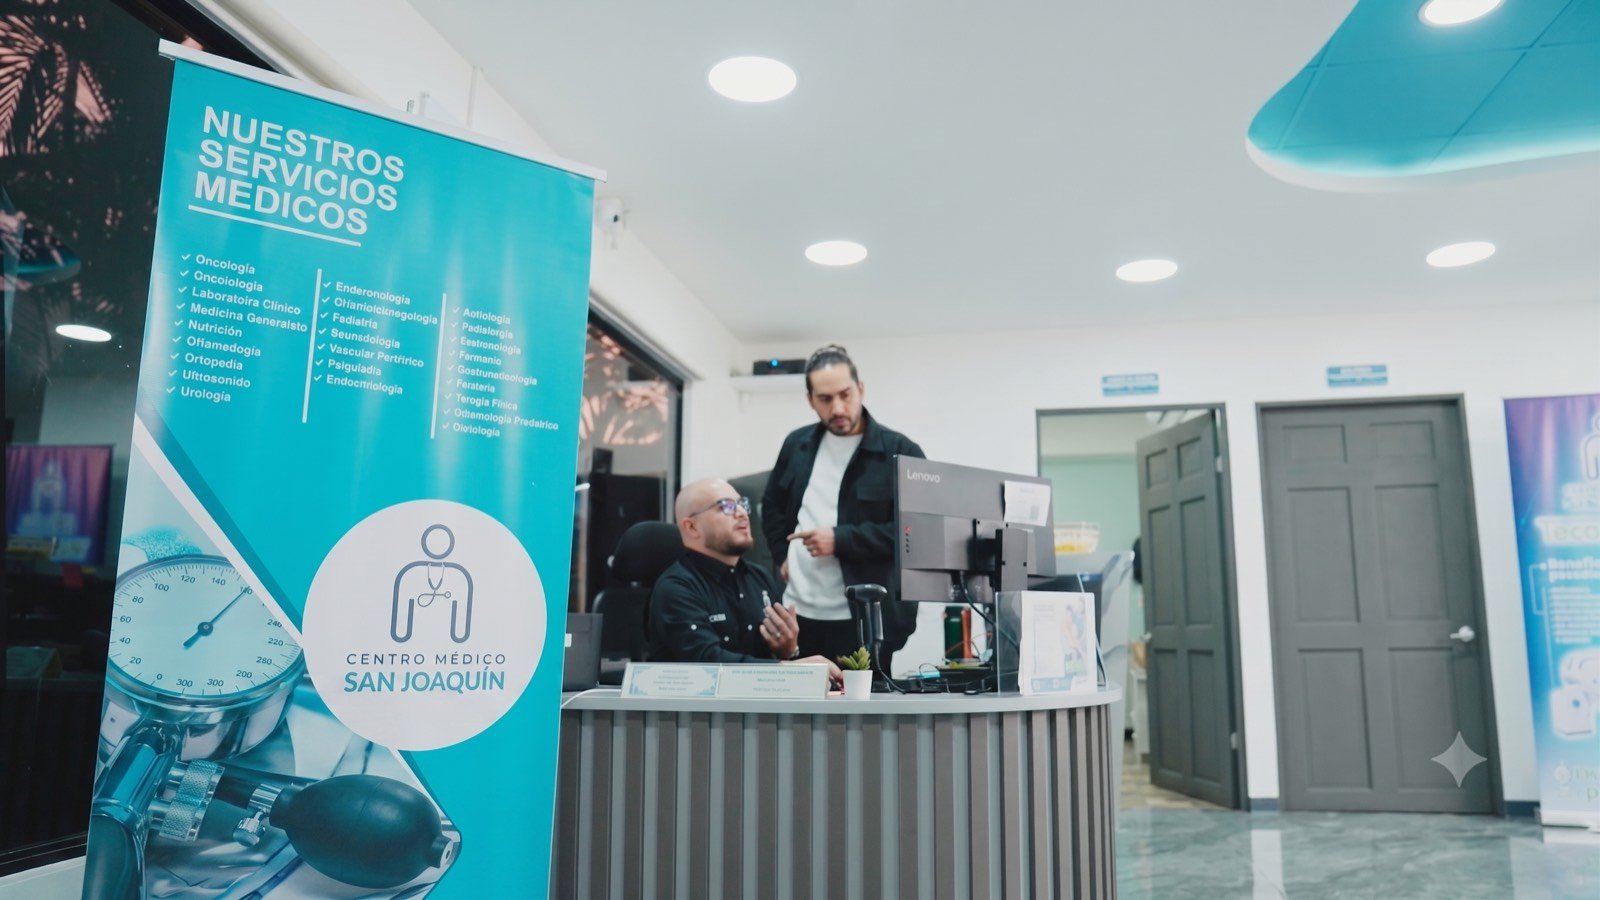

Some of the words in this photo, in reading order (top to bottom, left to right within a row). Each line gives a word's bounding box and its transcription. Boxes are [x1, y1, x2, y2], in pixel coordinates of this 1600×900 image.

[203, 105, 404, 182] NUESTROS
[199, 139, 398, 212] SERVICIOS
[195, 171, 368, 235] MEDICOS
[195, 254, 256, 275] Oncología
[190, 302, 244, 321] Medicina
[188, 319, 242, 337] Nutrición
[329, 343, 375, 360] Vascular
[180, 386, 231, 403] Urología
[906, 469, 941, 484] Lenovo
[180, 574, 196, 584] 120
[211, 576, 226, 586] 140
[154, 582, 170, 592] 100
[132, 595, 144, 604] 80
[119, 615, 132, 623] 60
[119, 637, 131, 645] 40
[268, 637, 284, 647] 220
[129, 656, 142, 665] 20
[256, 656, 273, 665] 280
[346, 653, 425, 665] CENTRO
[435, 651, 506, 665] MÉDICO
[156, 673, 163, 681] 0
[236, 669, 253, 679] 200
[176, 678, 193, 688] 300
[207, 678, 224, 687] 300
[343, 671, 395, 692] SAN
[401, 666, 505, 694] JOAQUÍN
